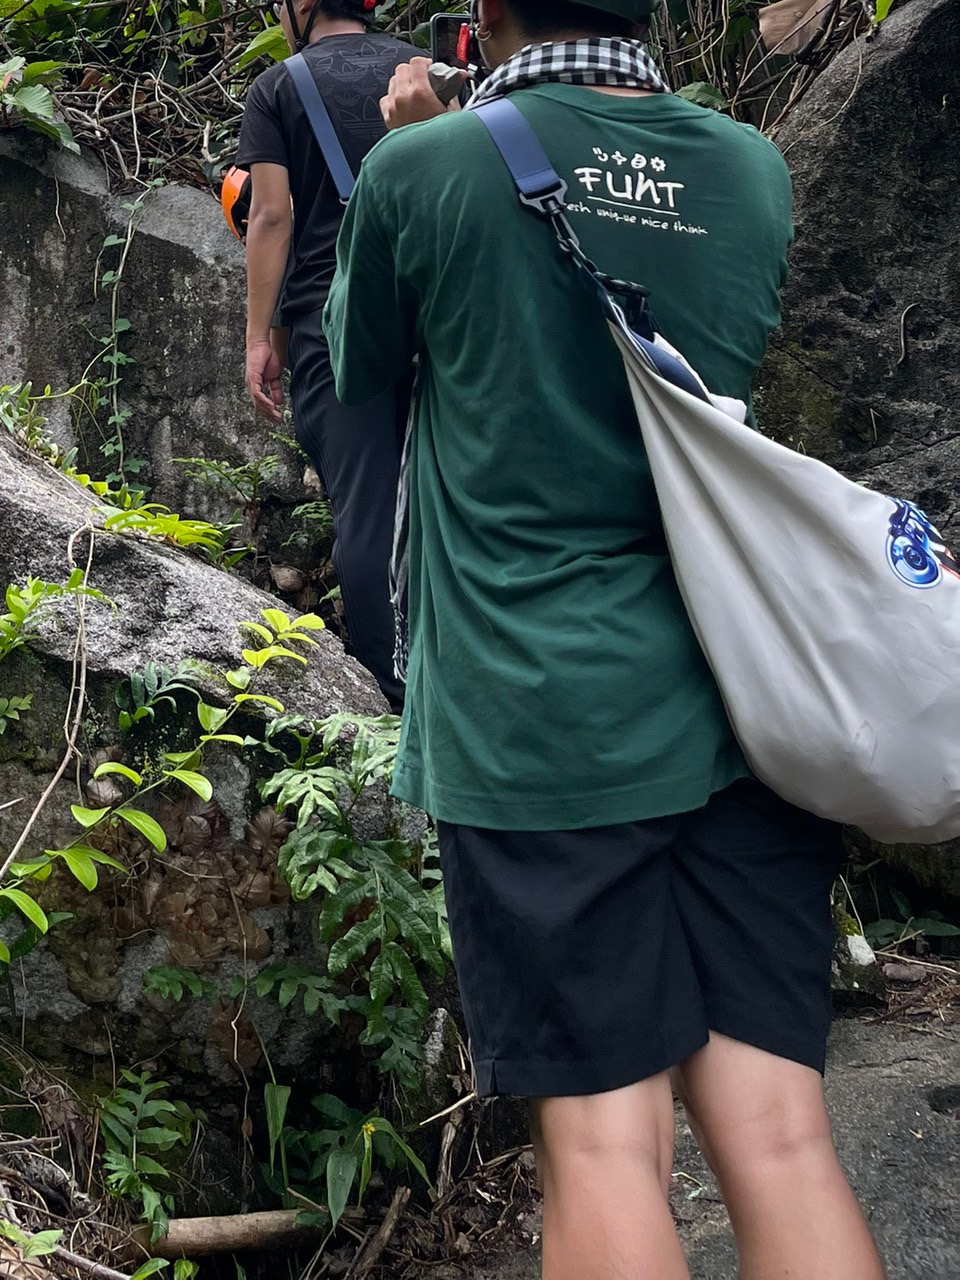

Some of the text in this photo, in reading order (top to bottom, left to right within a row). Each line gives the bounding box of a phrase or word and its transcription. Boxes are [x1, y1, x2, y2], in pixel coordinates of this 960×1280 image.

[596, 208, 637, 224] unique
[641, 216, 669, 230] nice
[673, 220, 709, 235] think
